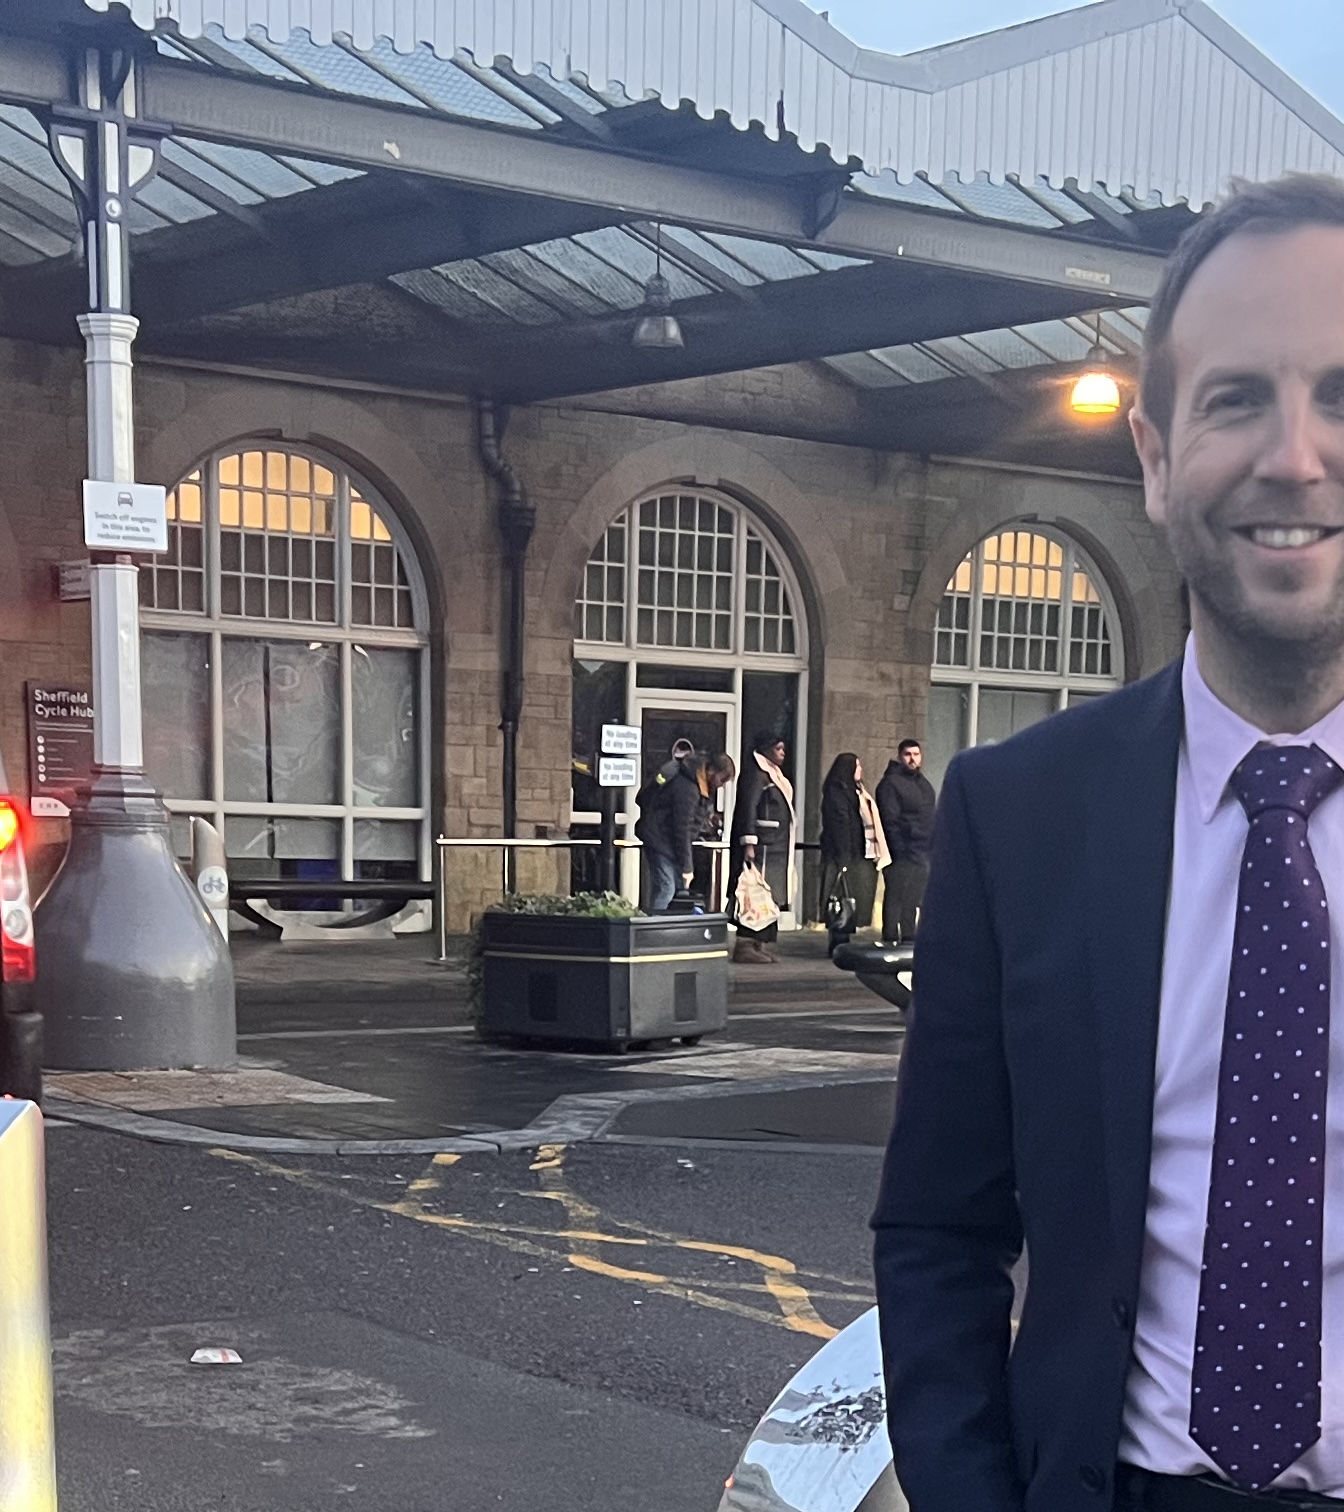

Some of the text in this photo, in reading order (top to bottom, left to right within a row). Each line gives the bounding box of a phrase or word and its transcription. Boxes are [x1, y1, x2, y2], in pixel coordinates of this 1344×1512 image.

[34, 689, 89, 704] Sheffield
[35, 703, 94, 718] Cycle Hub
